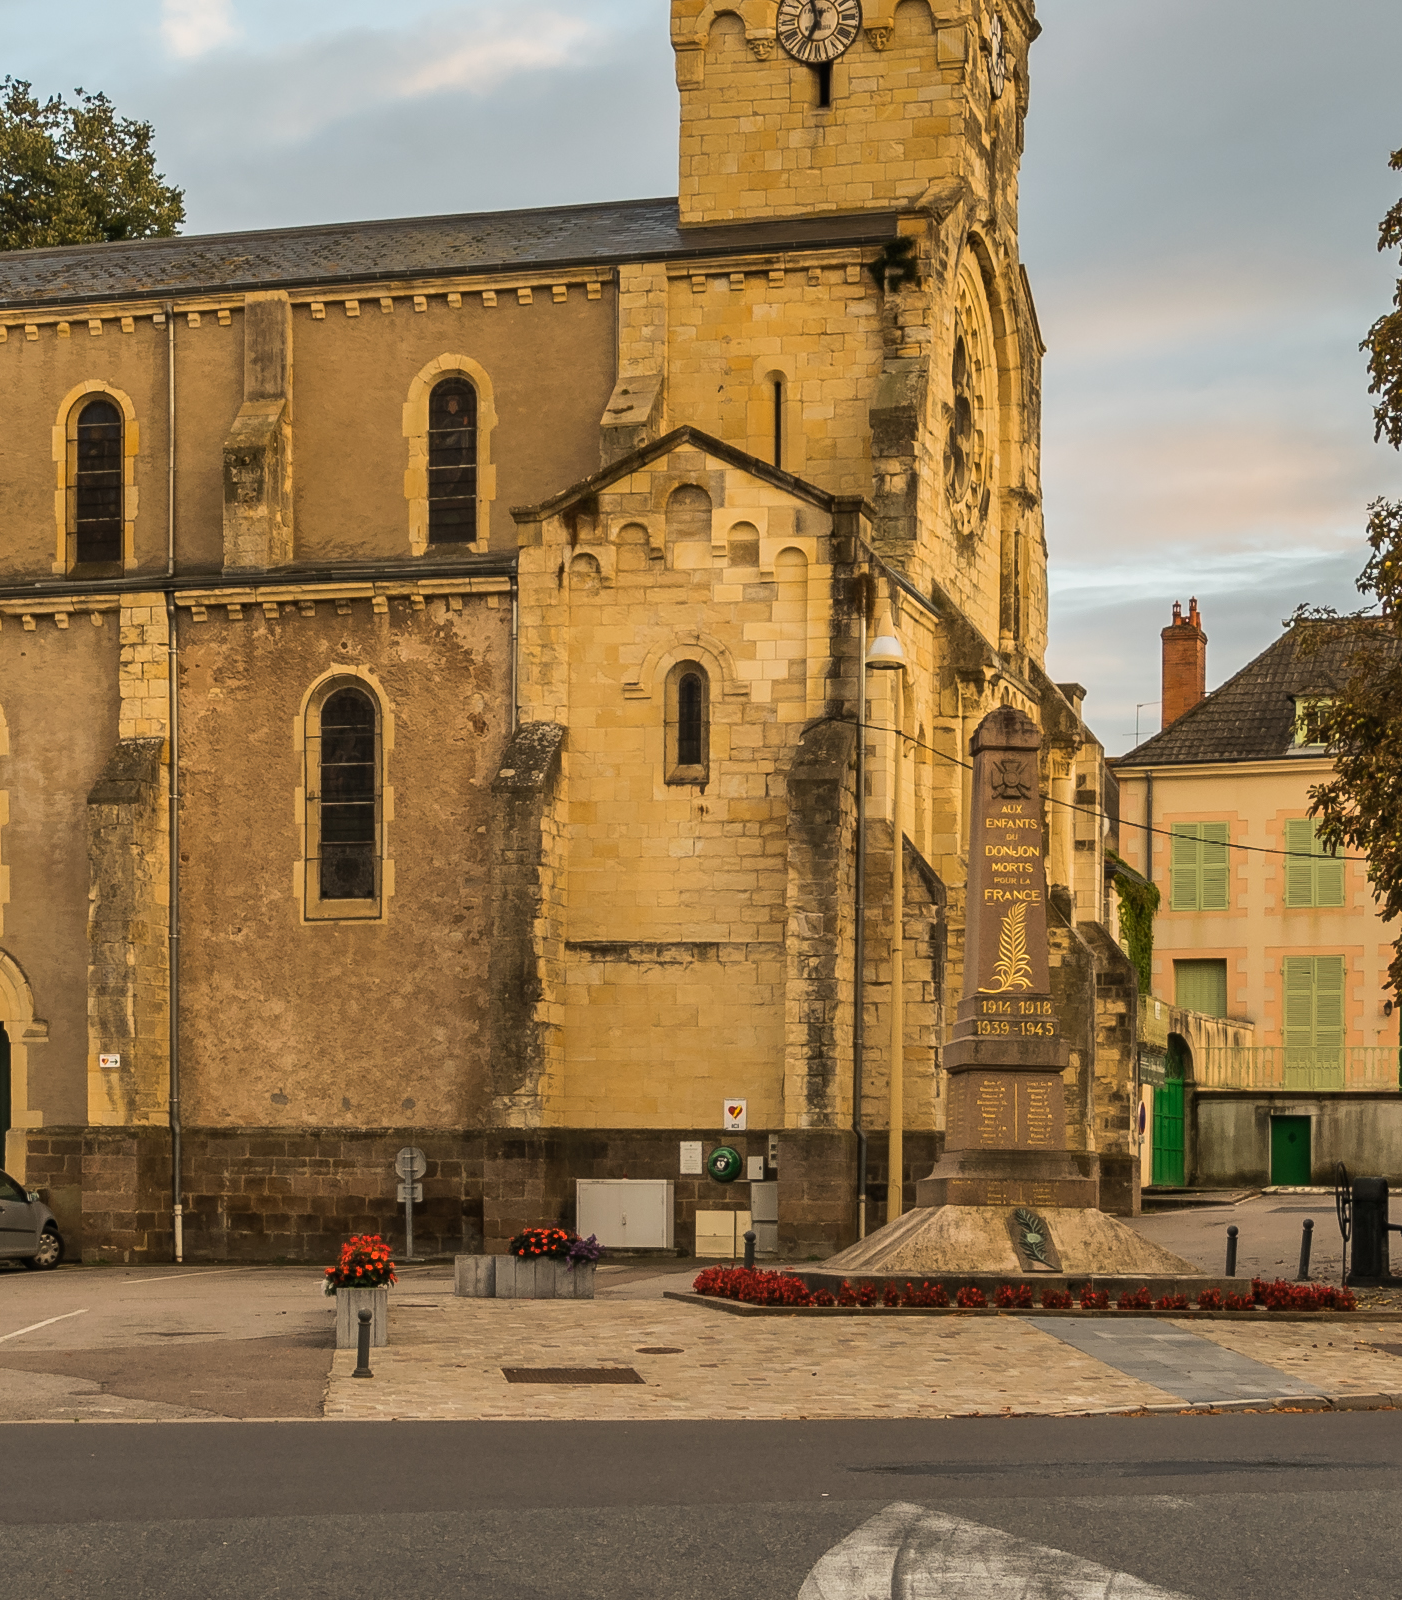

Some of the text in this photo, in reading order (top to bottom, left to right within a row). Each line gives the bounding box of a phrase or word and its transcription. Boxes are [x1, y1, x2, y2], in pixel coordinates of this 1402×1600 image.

[1001, 804, 1023, 814] AUX
[985, 818, 1038, 829] ENFANTS
[985, 845, 1039, 857] DONJON
[991, 862, 1033, 874] MORTS
[994, 877, 1017, 885] POUR
[984, 888, 1041, 902] FRANCE
